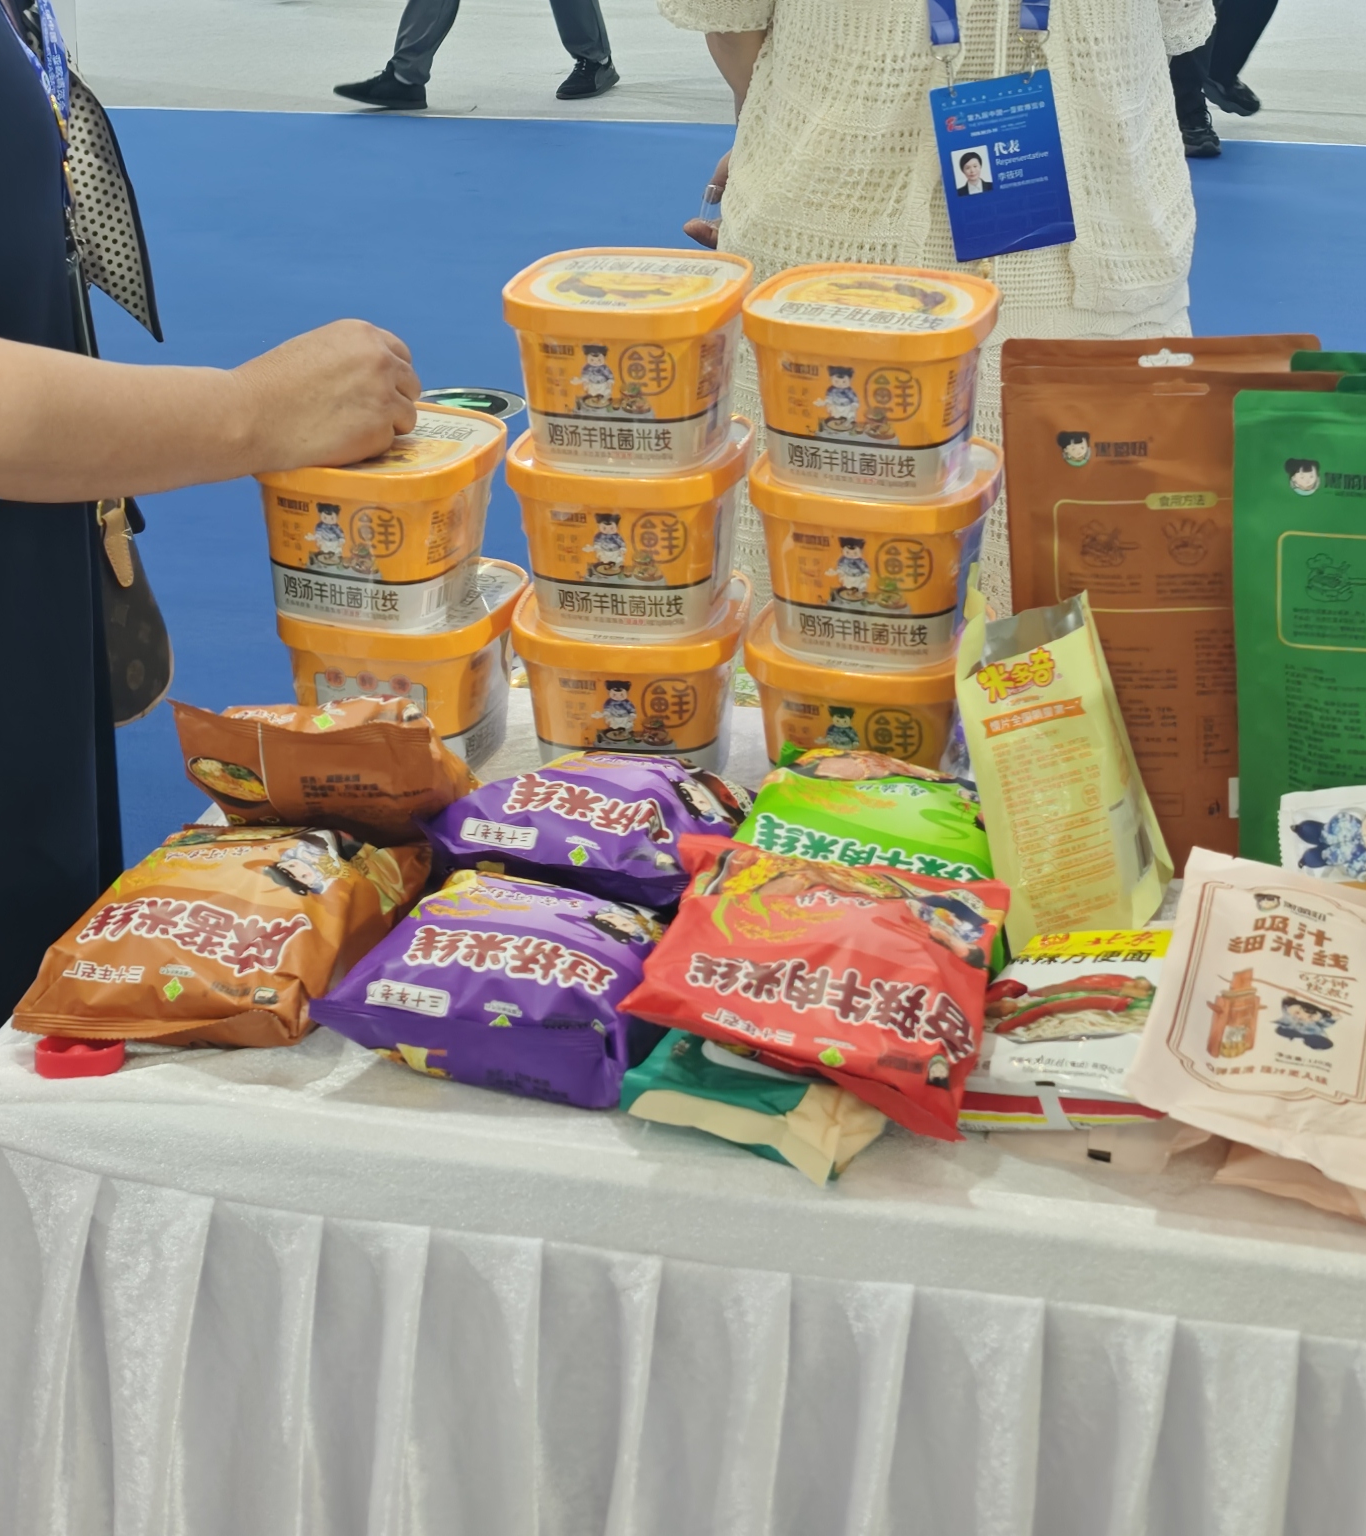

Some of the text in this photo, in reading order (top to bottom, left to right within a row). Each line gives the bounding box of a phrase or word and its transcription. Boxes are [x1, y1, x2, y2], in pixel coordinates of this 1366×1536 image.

[993, 139, 1021, 156] 代表
[777, 301, 945, 331] 鸡汤羊肚菌米线
[548, 422, 673, 452] 鸡汤羊肚菌米线
[787, 442, 917, 479] 鸡汤羊肚菌米线
[284, 573, 399, 612] 鸡汤羊肚菌米线
[557, 589, 684, 618] 鸡汤羊肚菌米线
[798, 612, 929, 648] 鸡汤羊肚菌米线
[976, 645, 1055, 703] 米多奇
[463, 823, 532, 845] 三十年老厂
[76, 896, 312, 978] 麻酱米线
[1252, 914, 1333, 947] 吸汁
[402, 925, 618, 995] 过桥米线
[1227, 933, 1350, 972] 细米线
[62, 959, 146, 985] 三十年老厂
[685, 952, 975, 1064] 香辣牛肉米线
[701, 1007, 796, 1046] 三十年老厂
